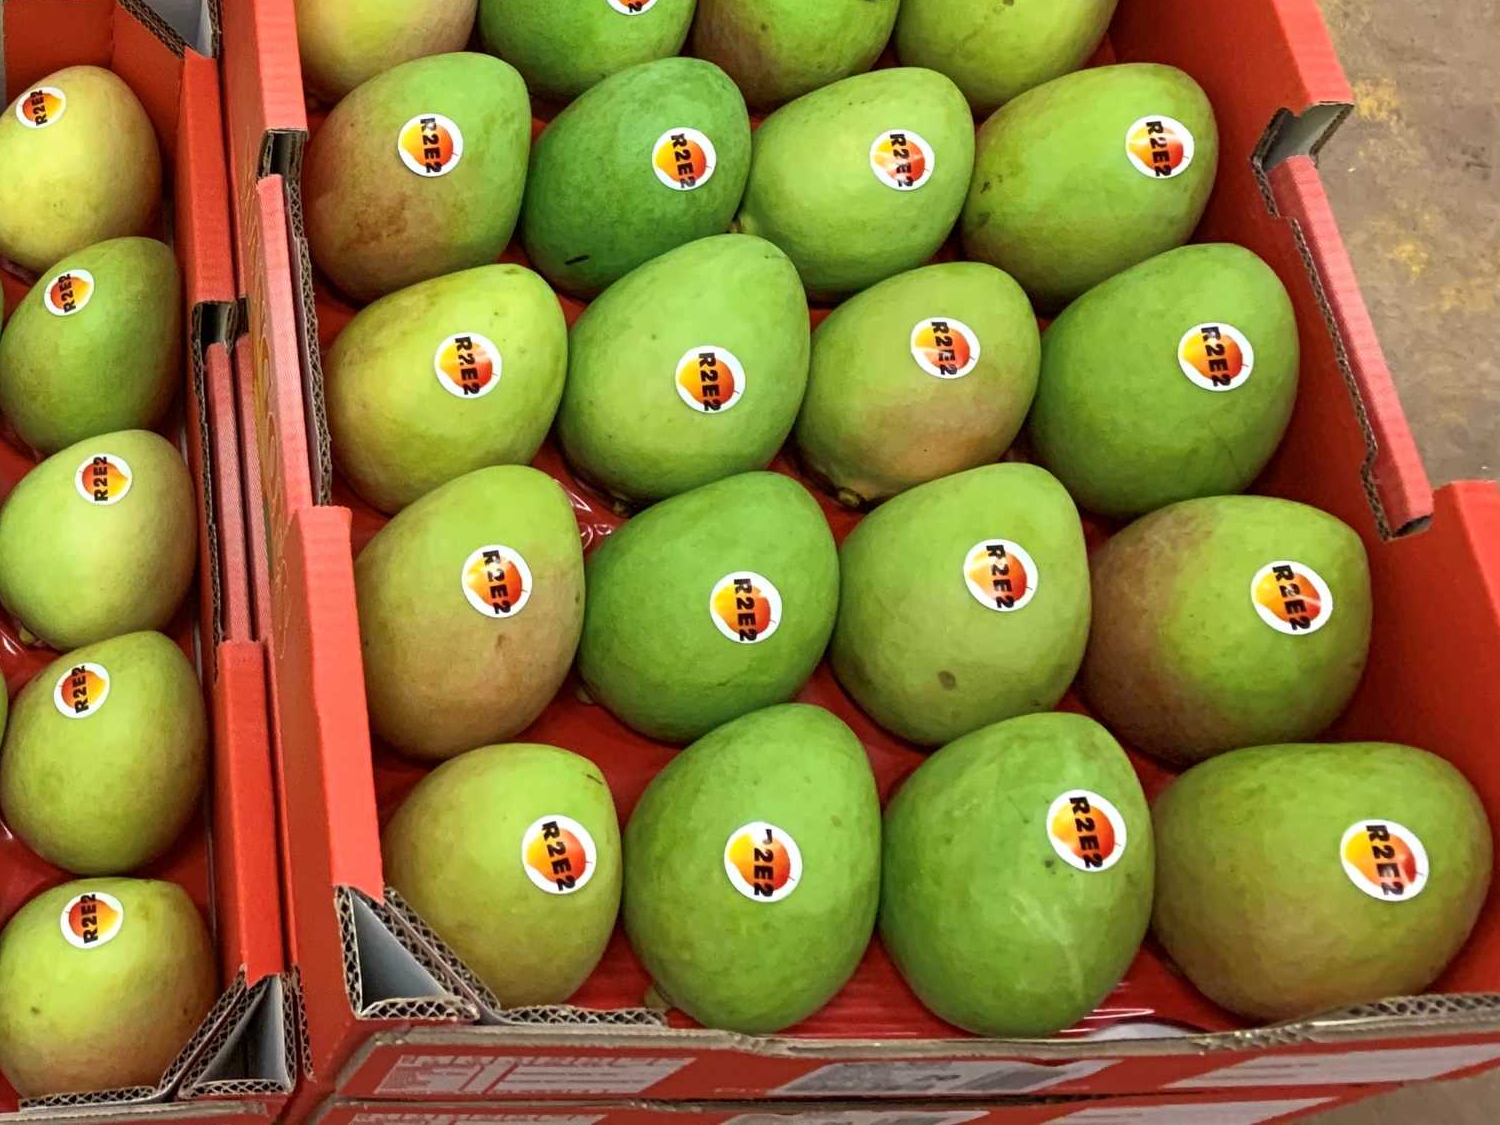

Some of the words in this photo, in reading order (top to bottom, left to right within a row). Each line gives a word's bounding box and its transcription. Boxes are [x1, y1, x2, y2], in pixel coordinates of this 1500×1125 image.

[29, 90, 48, 126] R2E2
[420, 117, 443, 174] R2E2
[670, 133, 696, 189] R2E2
[1145, 120, 1172, 177] R2E2
[57, 273, 77, 313] R2E2
[931, 321, 958, 376] R2E2
[1200, 326, 1232, 387] R2E2
[698, 352, 723, 412] R2E2
[92, 456, 109, 502] R2E2
[482, 550, 512, 615] R2E2
[985, 544, 1016, 609] R2E2
[1272, 564, 1312, 631] R2E2
[733, 578, 760, 642] R2E2
[70, 667, 89, 714] R2E2
[542, 820, 576, 892] R2E2
[1069, 796, 1104, 869] R2E2
[1366, 824, 1404, 895] R2E2
[79, 893, 99, 944] R2E2
